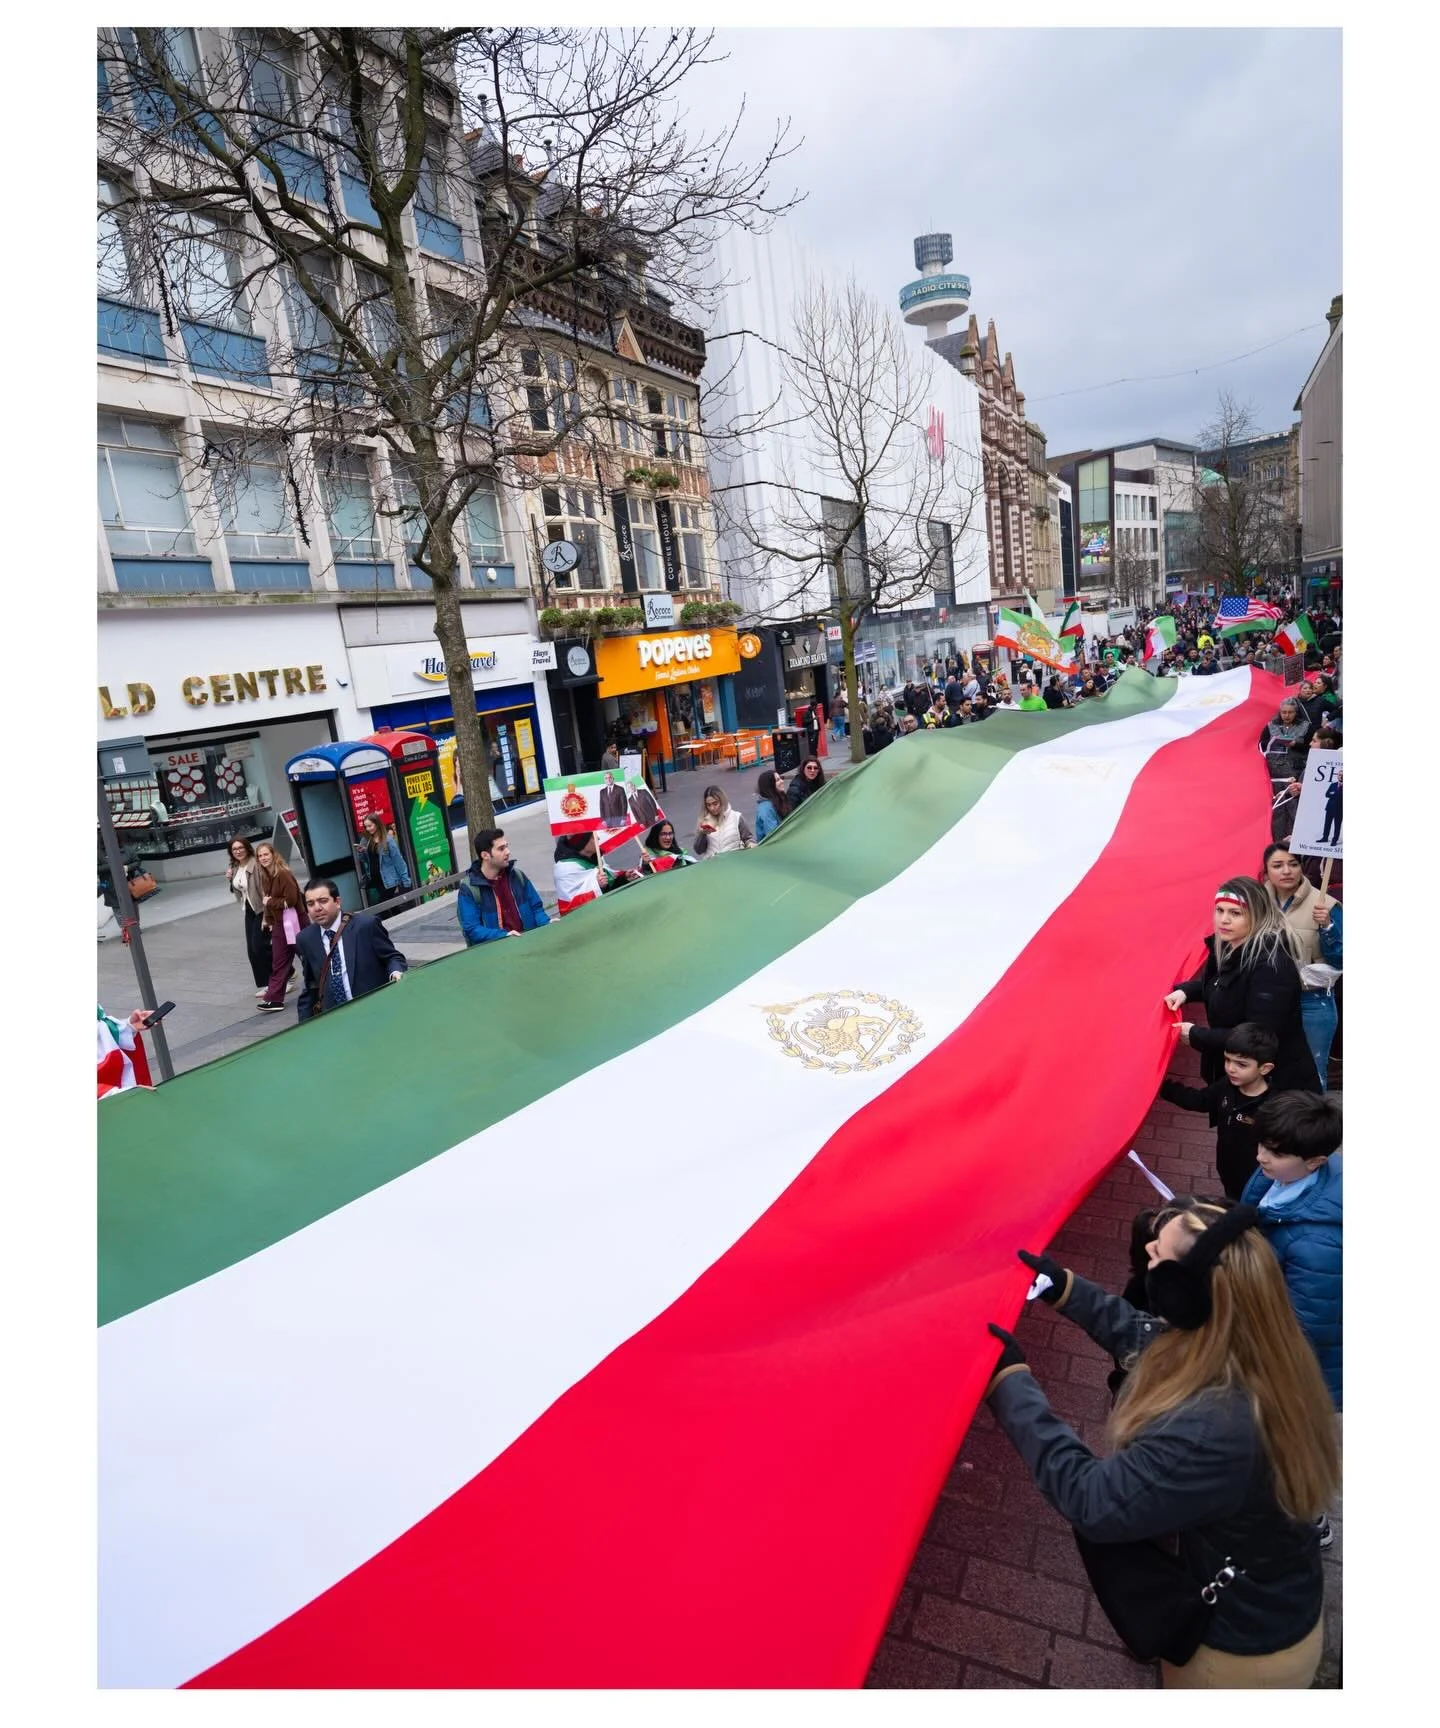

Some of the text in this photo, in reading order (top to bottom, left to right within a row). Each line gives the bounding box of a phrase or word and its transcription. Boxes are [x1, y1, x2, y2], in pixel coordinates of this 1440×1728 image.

[911, 285, 937, 297] RADIO
[647, 598, 671, 621] Rococo
[532, 656, 551, 665] Travel
[533, 650, 549, 658] Hays
[181, 664, 327, 706] CENTRE
[167, 752, 200, 766] SALE
[406, 775, 420, 784] POWER
[408, 781, 433, 796] CALL 105
